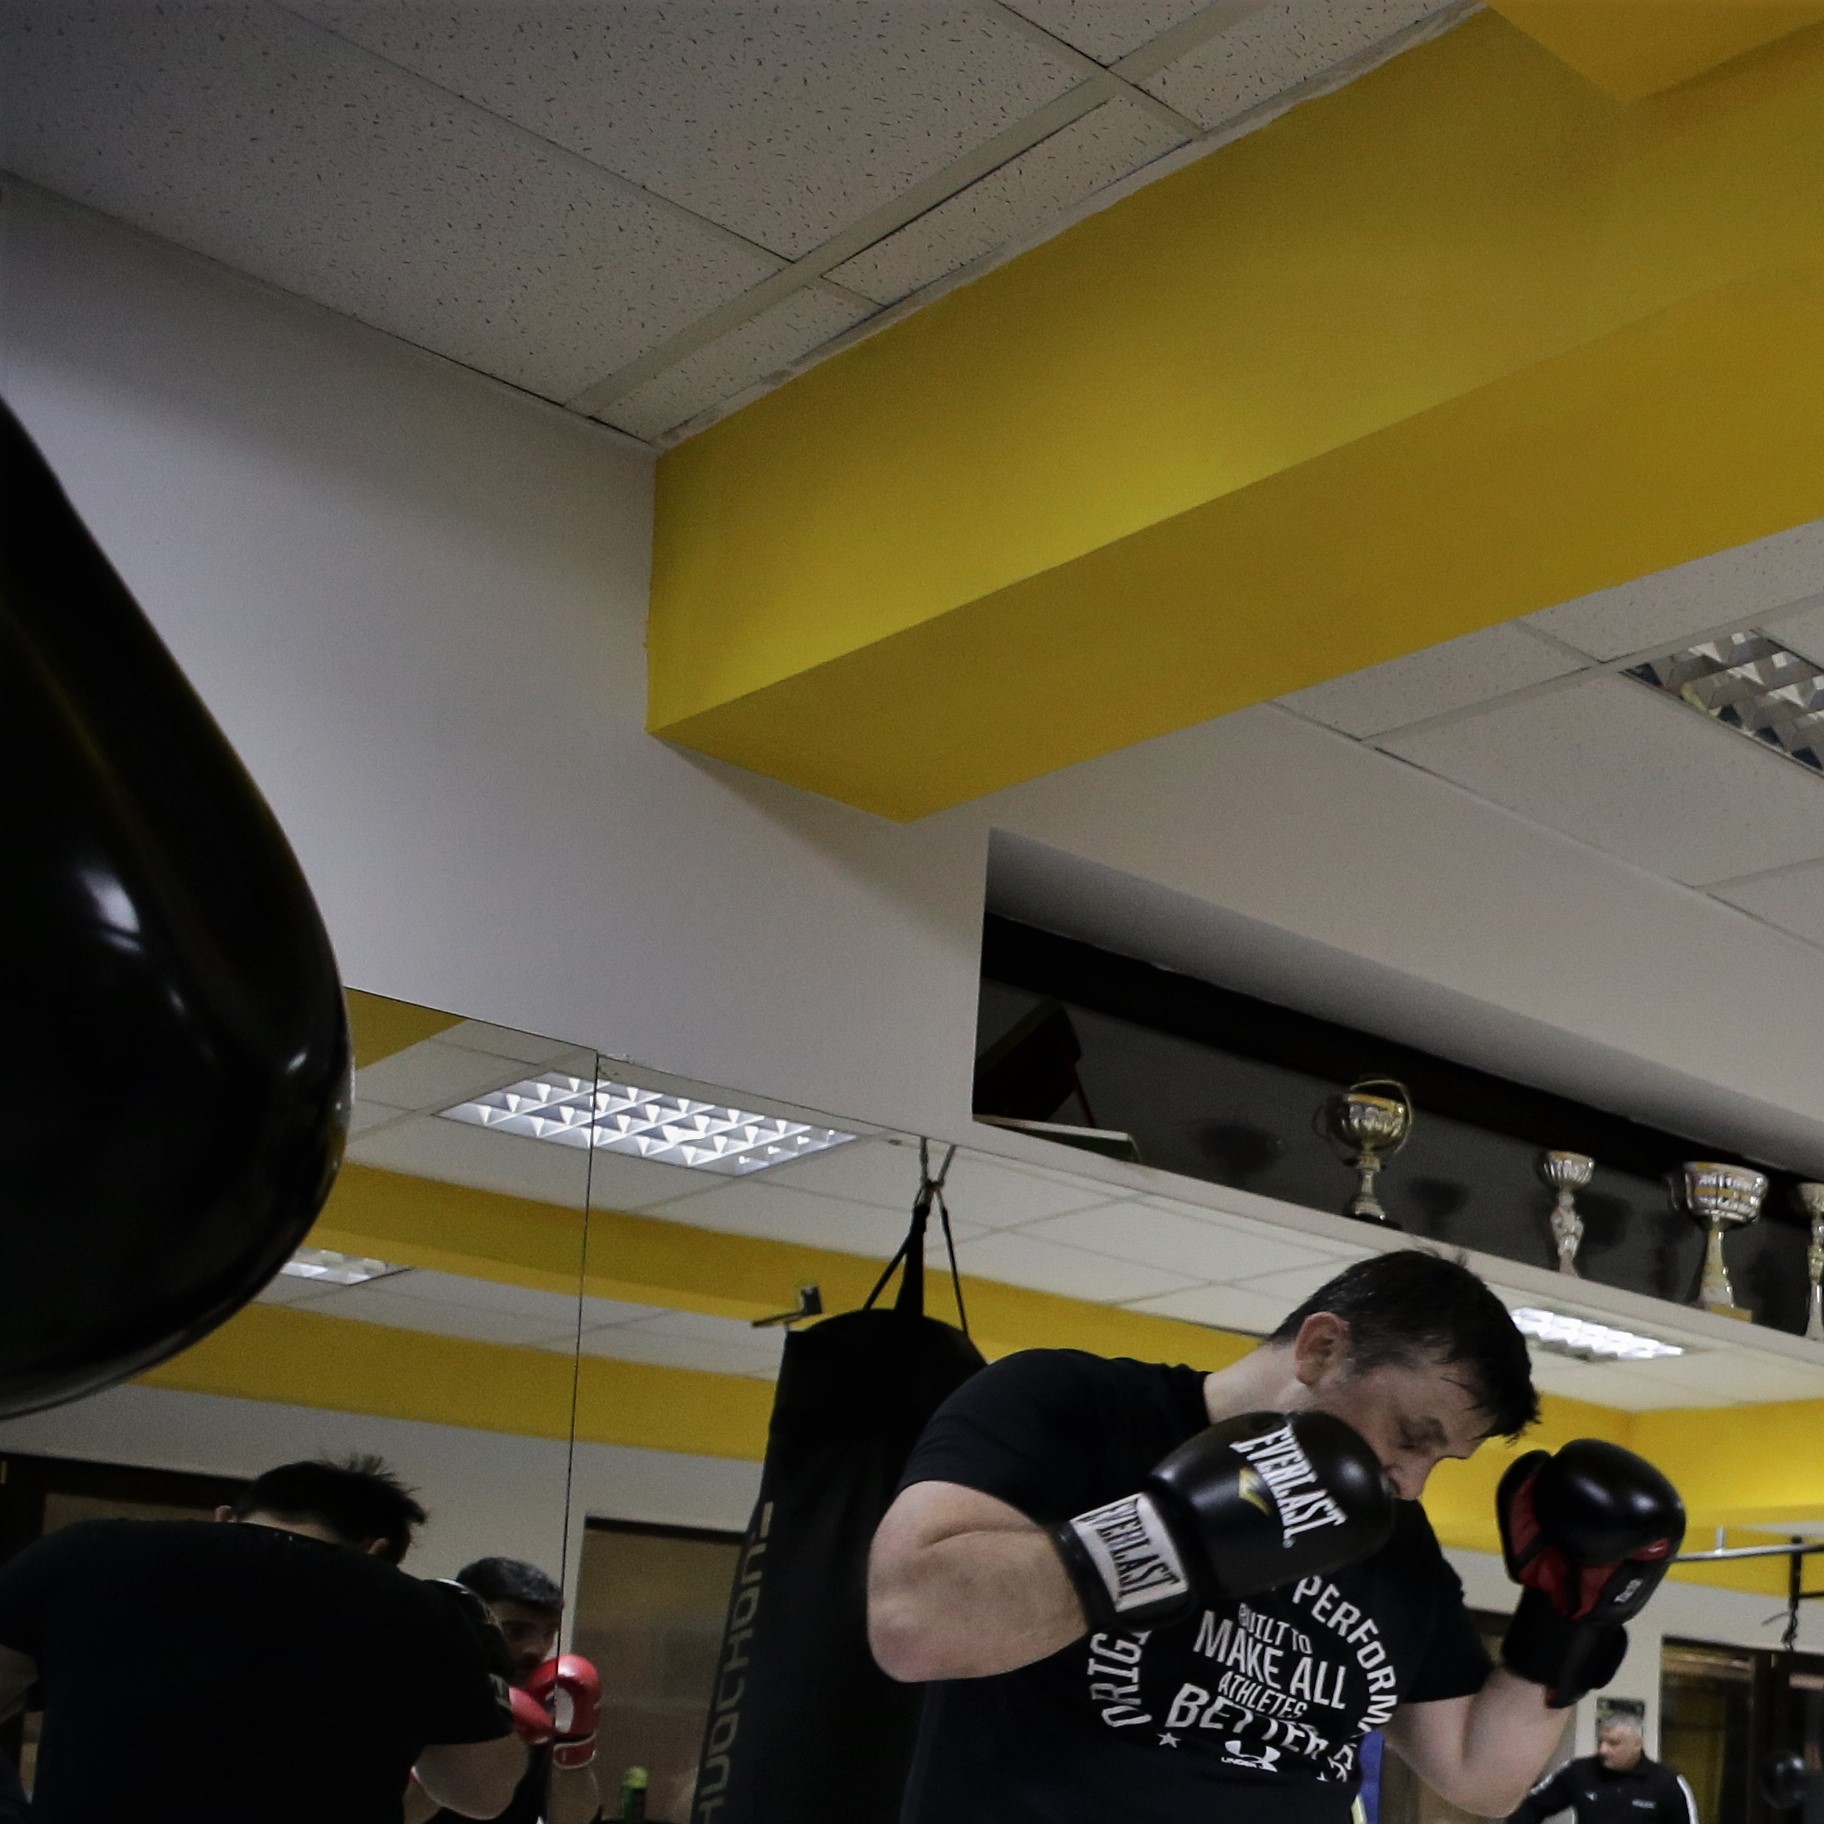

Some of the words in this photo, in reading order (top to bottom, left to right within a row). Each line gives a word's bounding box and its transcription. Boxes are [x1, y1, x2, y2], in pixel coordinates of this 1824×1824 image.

[1229, 1422, 1348, 1541] EVERLAST
[1077, 1497, 1181, 1598] EVERLAST
[1193, 1609, 1285, 1690] MAKE
[1289, 1656, 1347, 1710] ALL
[1238, 1603, 1288, 1646] BUILT
[1290, 1626, 1314, 1655] TO
[1087, 1630, 1152, 1728] ORIG
[1218, 1671, 1308, 1719] ATHLETES
